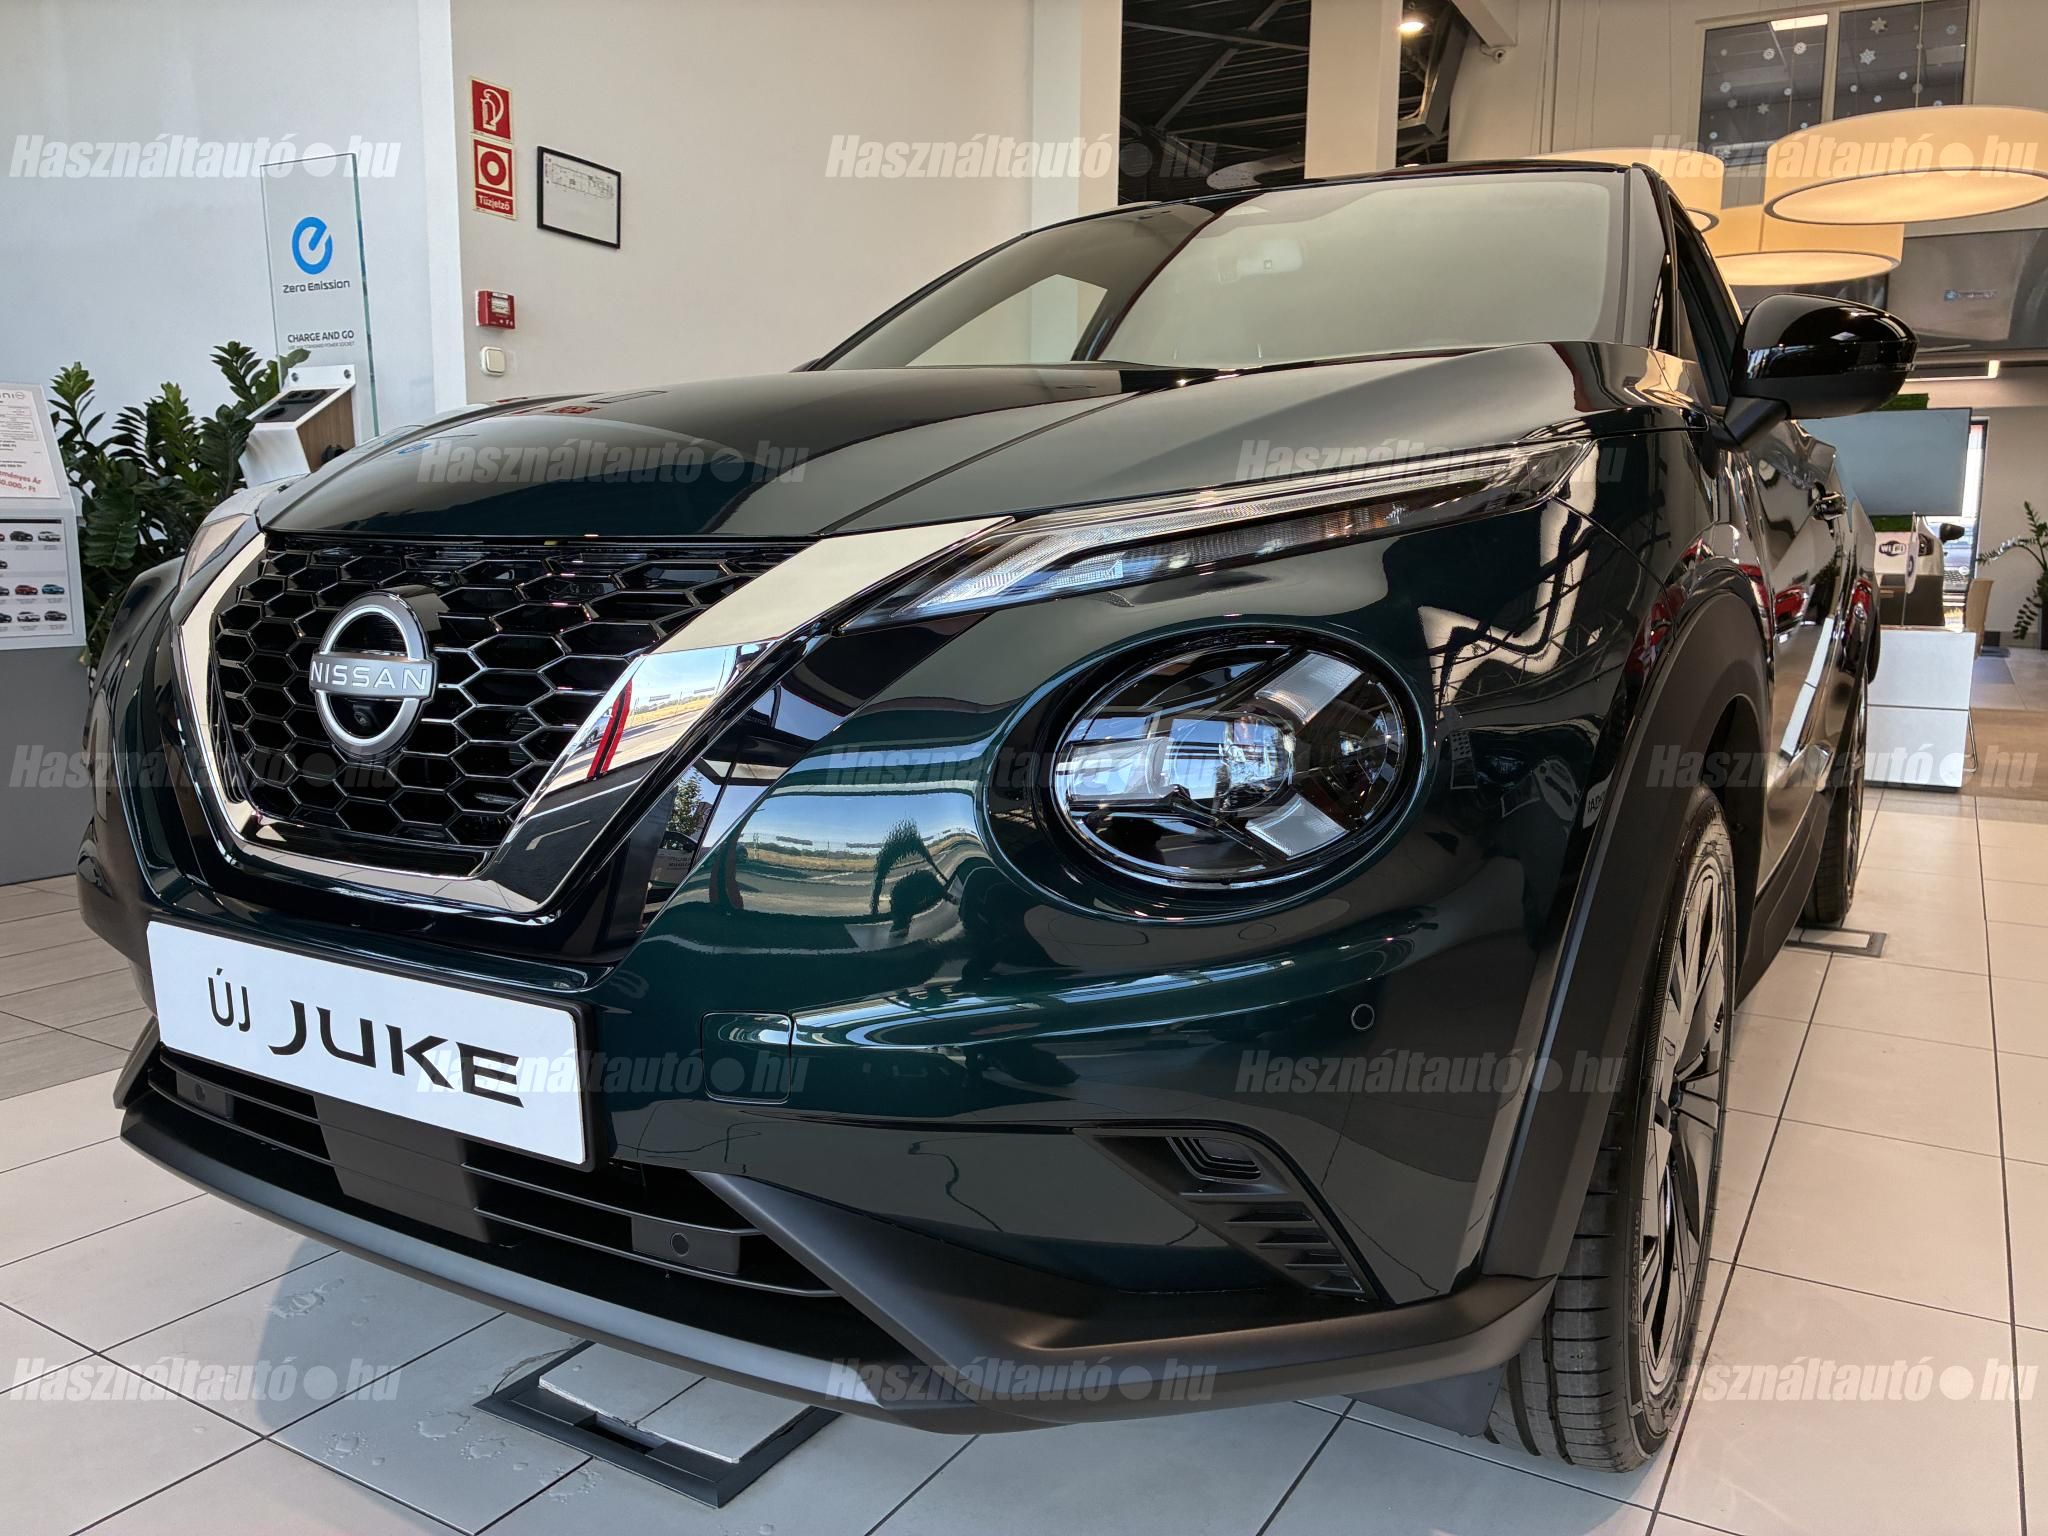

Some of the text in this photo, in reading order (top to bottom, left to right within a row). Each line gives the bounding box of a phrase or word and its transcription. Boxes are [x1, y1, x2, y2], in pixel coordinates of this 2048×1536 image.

[283, 280, 351, 294] Zero Emission
[288, 330, 355, 343] CHARGE AND GO
[310, 661, 428, 690] NISSAN
[207, 967, 524, 1109] ÚJ JUKE
